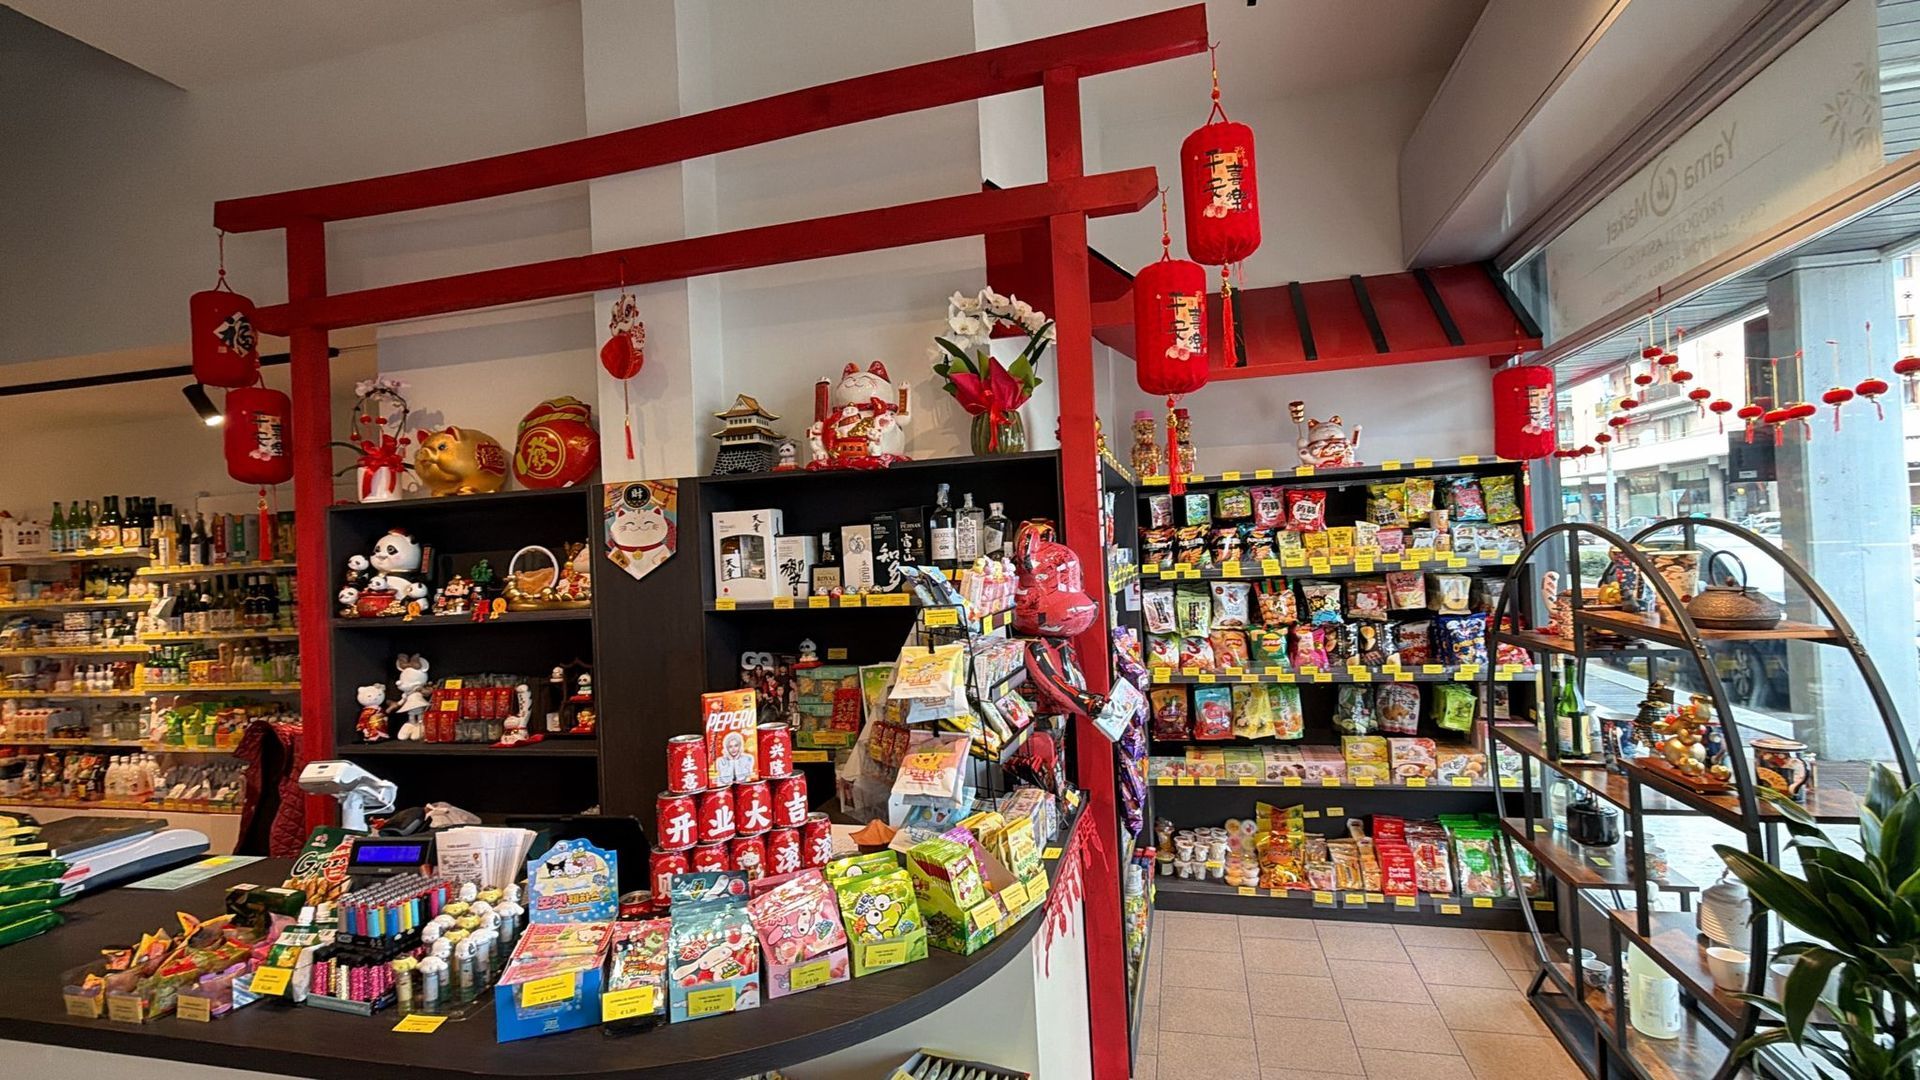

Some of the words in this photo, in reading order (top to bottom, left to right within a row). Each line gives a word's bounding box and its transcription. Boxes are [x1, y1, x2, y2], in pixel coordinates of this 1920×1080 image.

[526, 436, 559, 470] 發
[741, 651, 774, 673] GQ
[707, 707, 756, 733] PEPERO
[680, 756, 699, 790] 生意
[768, 742, 786, 776] 兴隆
[290, 850, 347, 881] Gyoza
